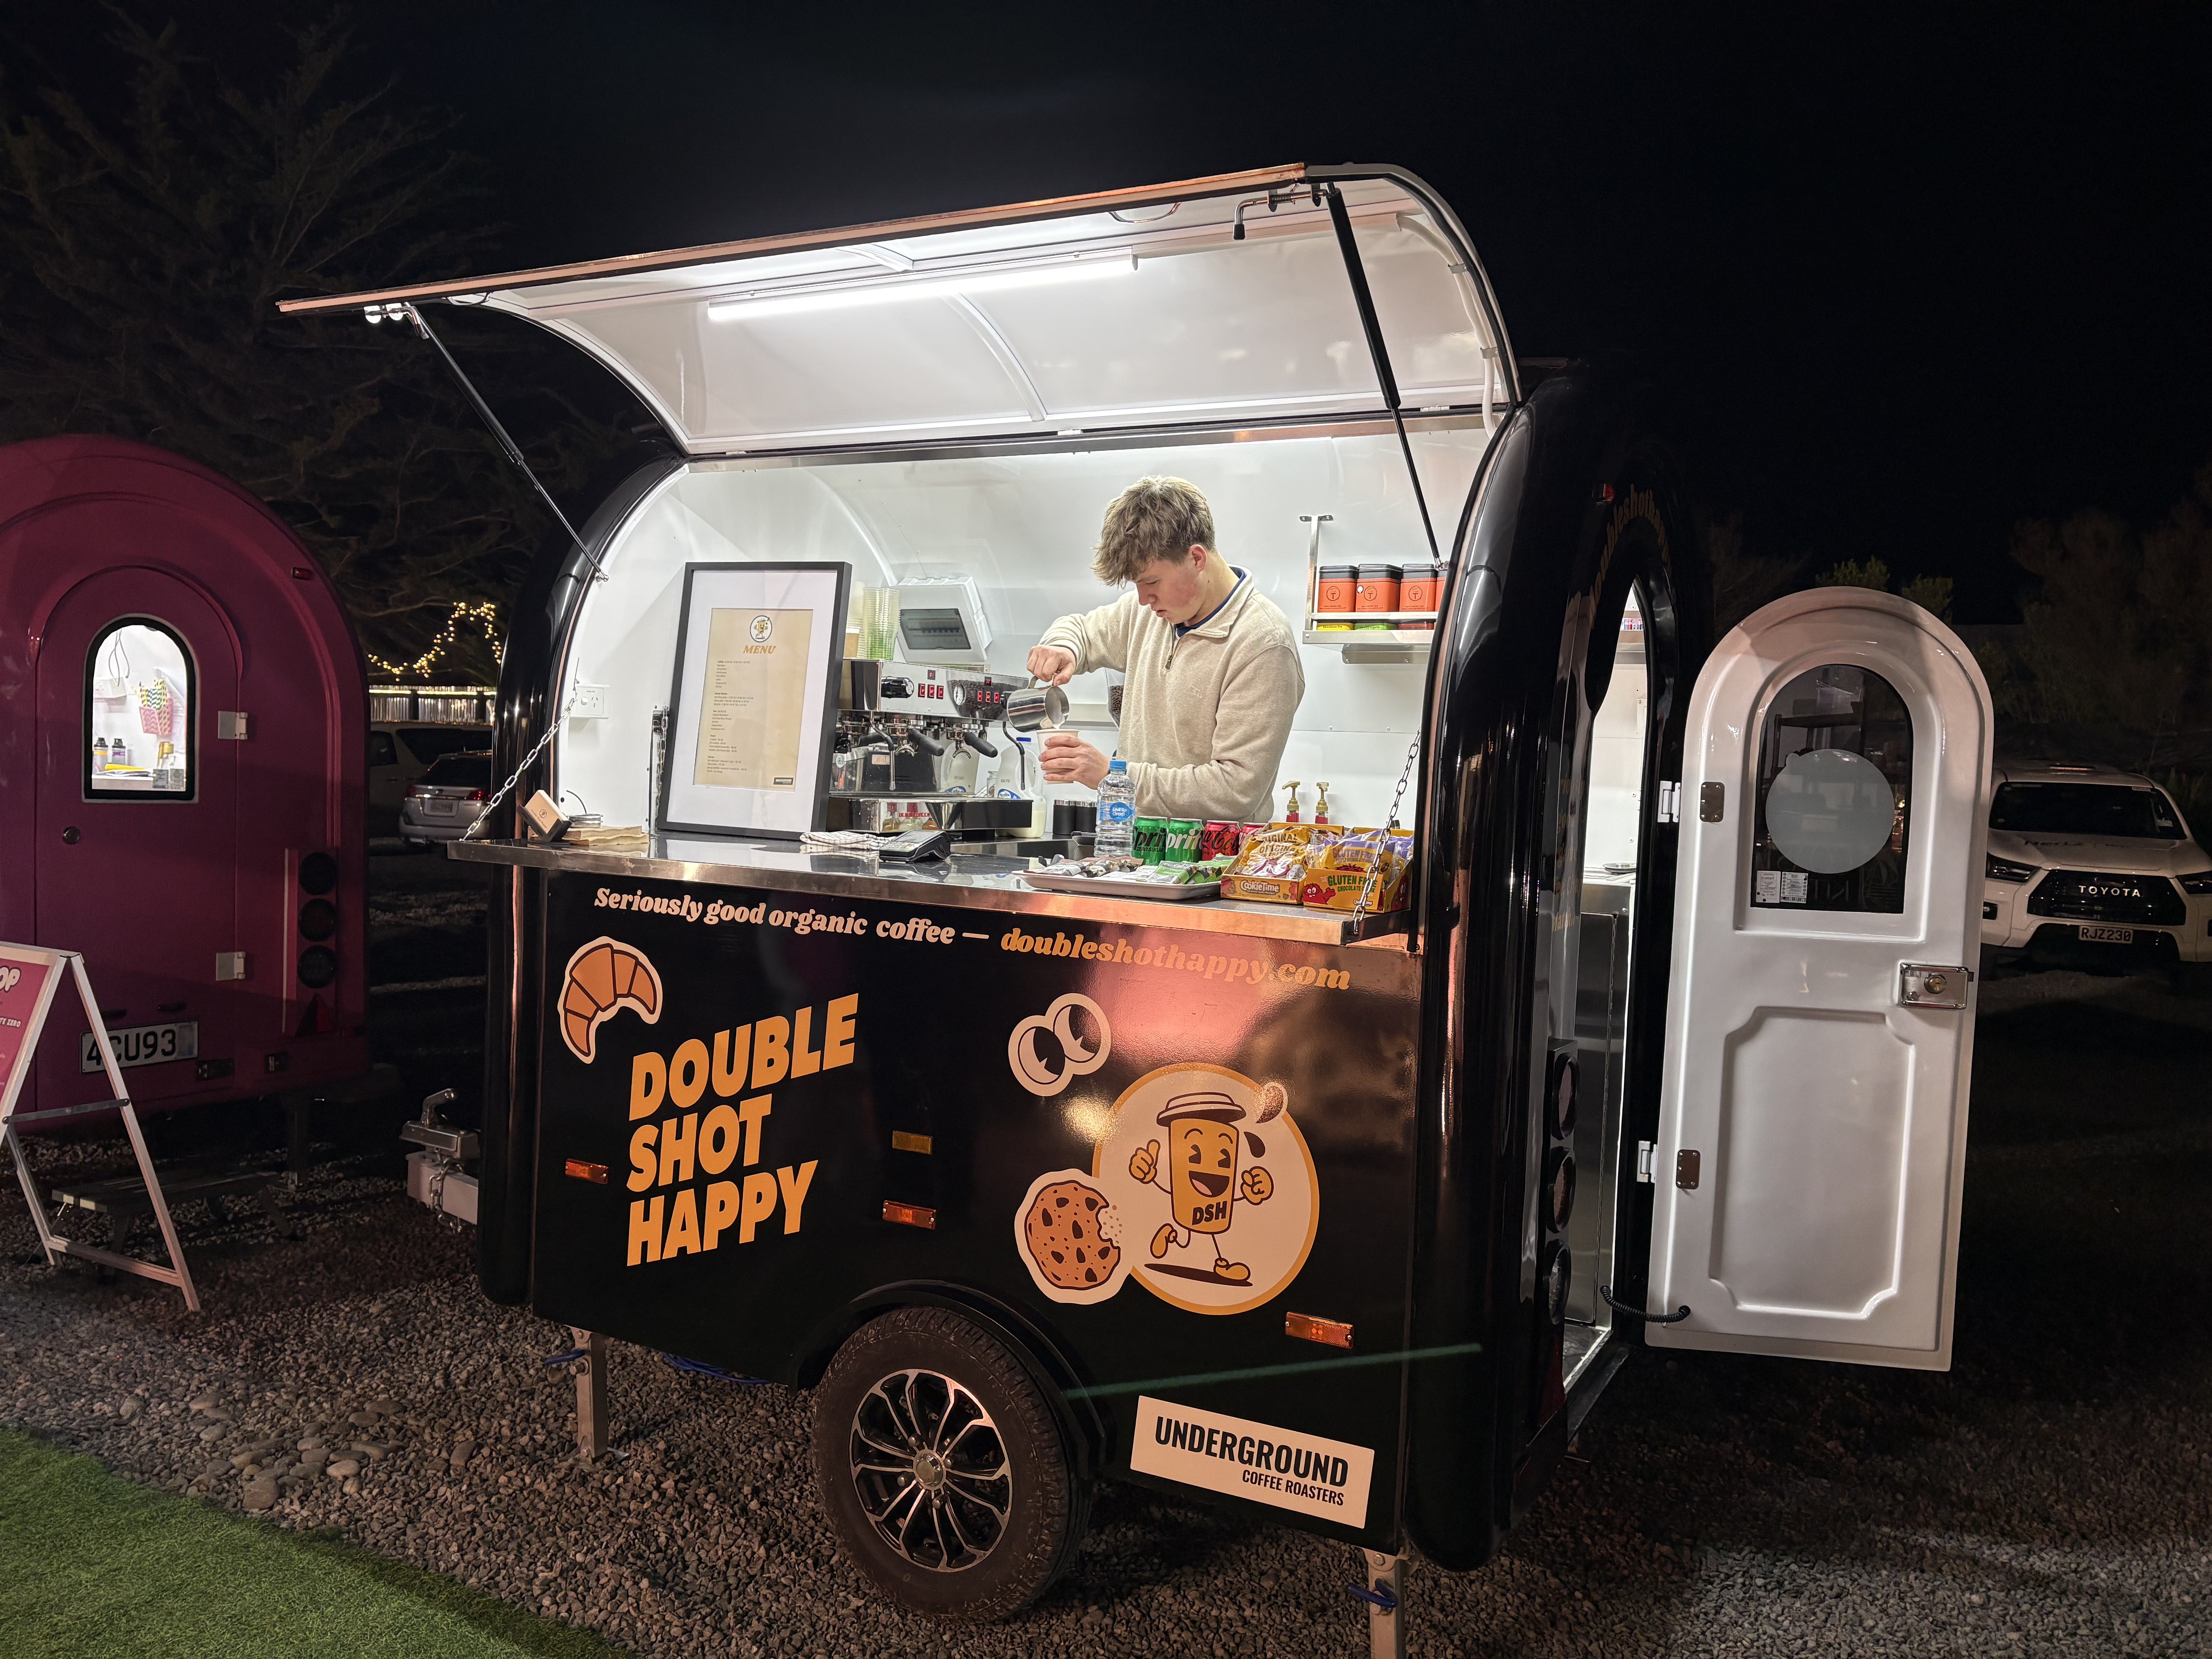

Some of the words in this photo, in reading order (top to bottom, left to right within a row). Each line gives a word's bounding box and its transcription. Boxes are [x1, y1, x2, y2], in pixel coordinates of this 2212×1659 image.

[743, 645, 776, 654] MENU
[1328, 875, 1357, 886] GLUTEN
[1358, 876, 1377, 888] FRE
[2079, 885, 2140, 897] TOYOTA
[594, 888, 703, 922] Seriously
[703, 899, 767, 925] good
[768, 908, 868, 934] organic
[876, 917, 955, 944] coffee
[1000, 927, 1350, 990] doubleshothappy.com
[7, 1018, 21, 1028] ZERO
[629, 993, 859, 1121] DOUBLE
[626, 1093, 772, 1192] SHOT
[627, 1159, 818, 1267] HAPPY
[1192, 1201, 1227, 1225] DSH
[1155, 1416, 1348, 1487] UNDERGROUND
[1242, 1470, 1283, 1491] COFFEE
[1285, 1480, 1344, 1506] ROASTERS
